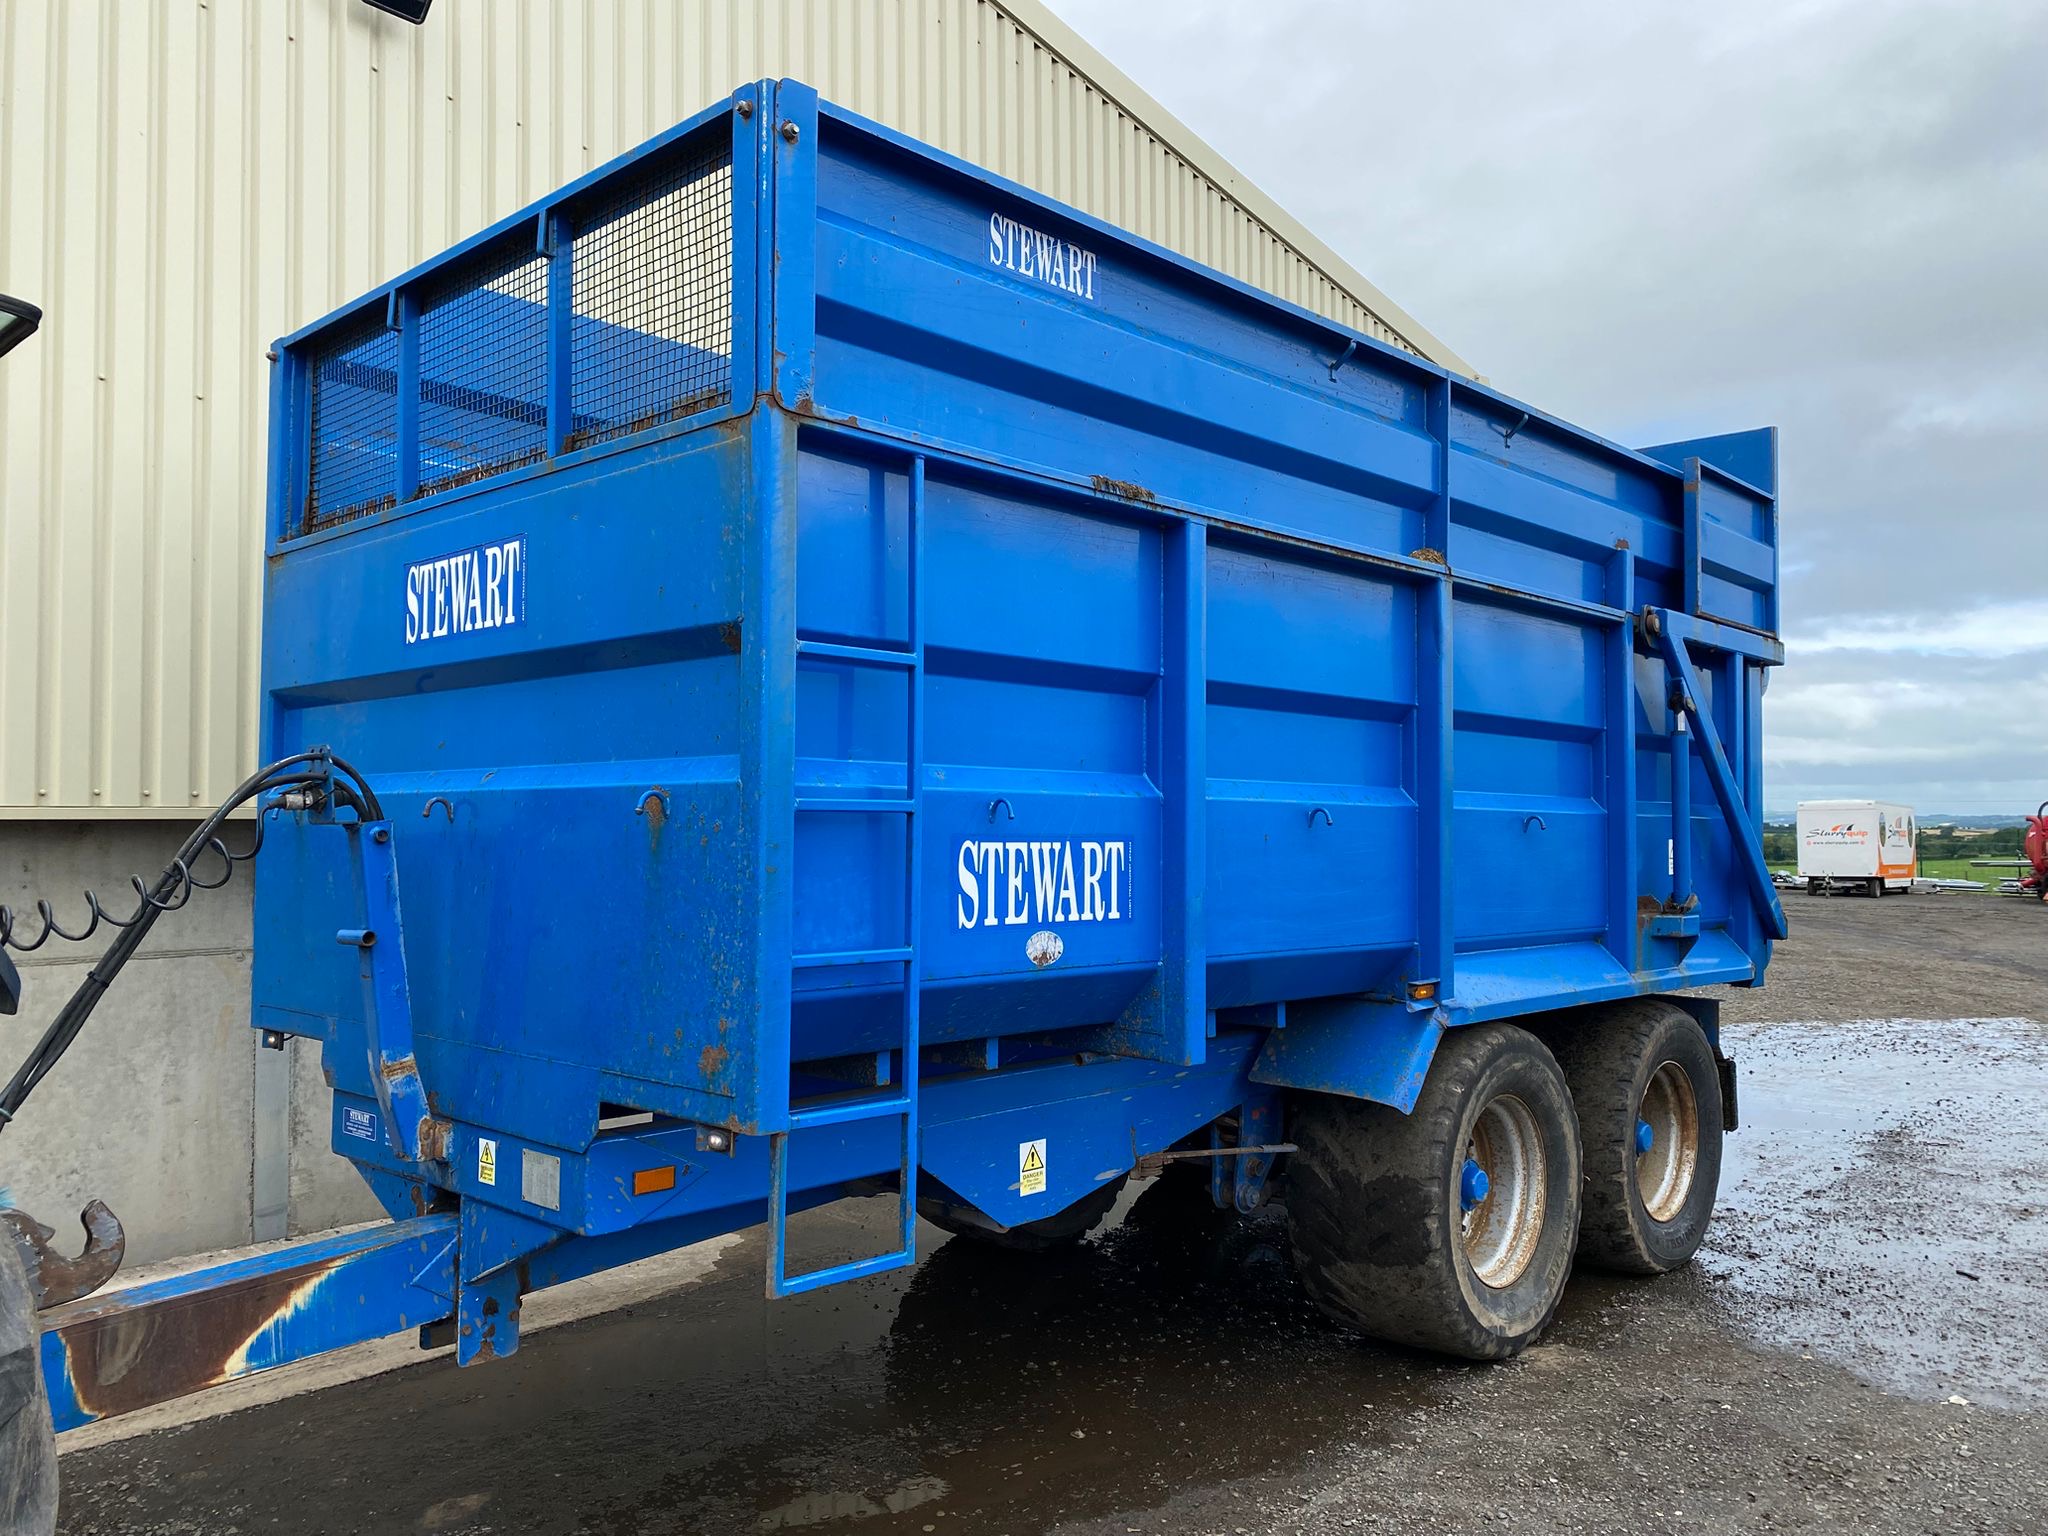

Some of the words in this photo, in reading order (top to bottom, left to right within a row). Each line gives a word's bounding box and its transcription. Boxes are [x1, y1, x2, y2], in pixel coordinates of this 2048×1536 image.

[990, 212, 1096, 300] STEWART
[406, 541, 520, 644] STEWART
[958, 840, 1125, 929] STEWART
[1023, 1171, 1043, 1180] DANGER
